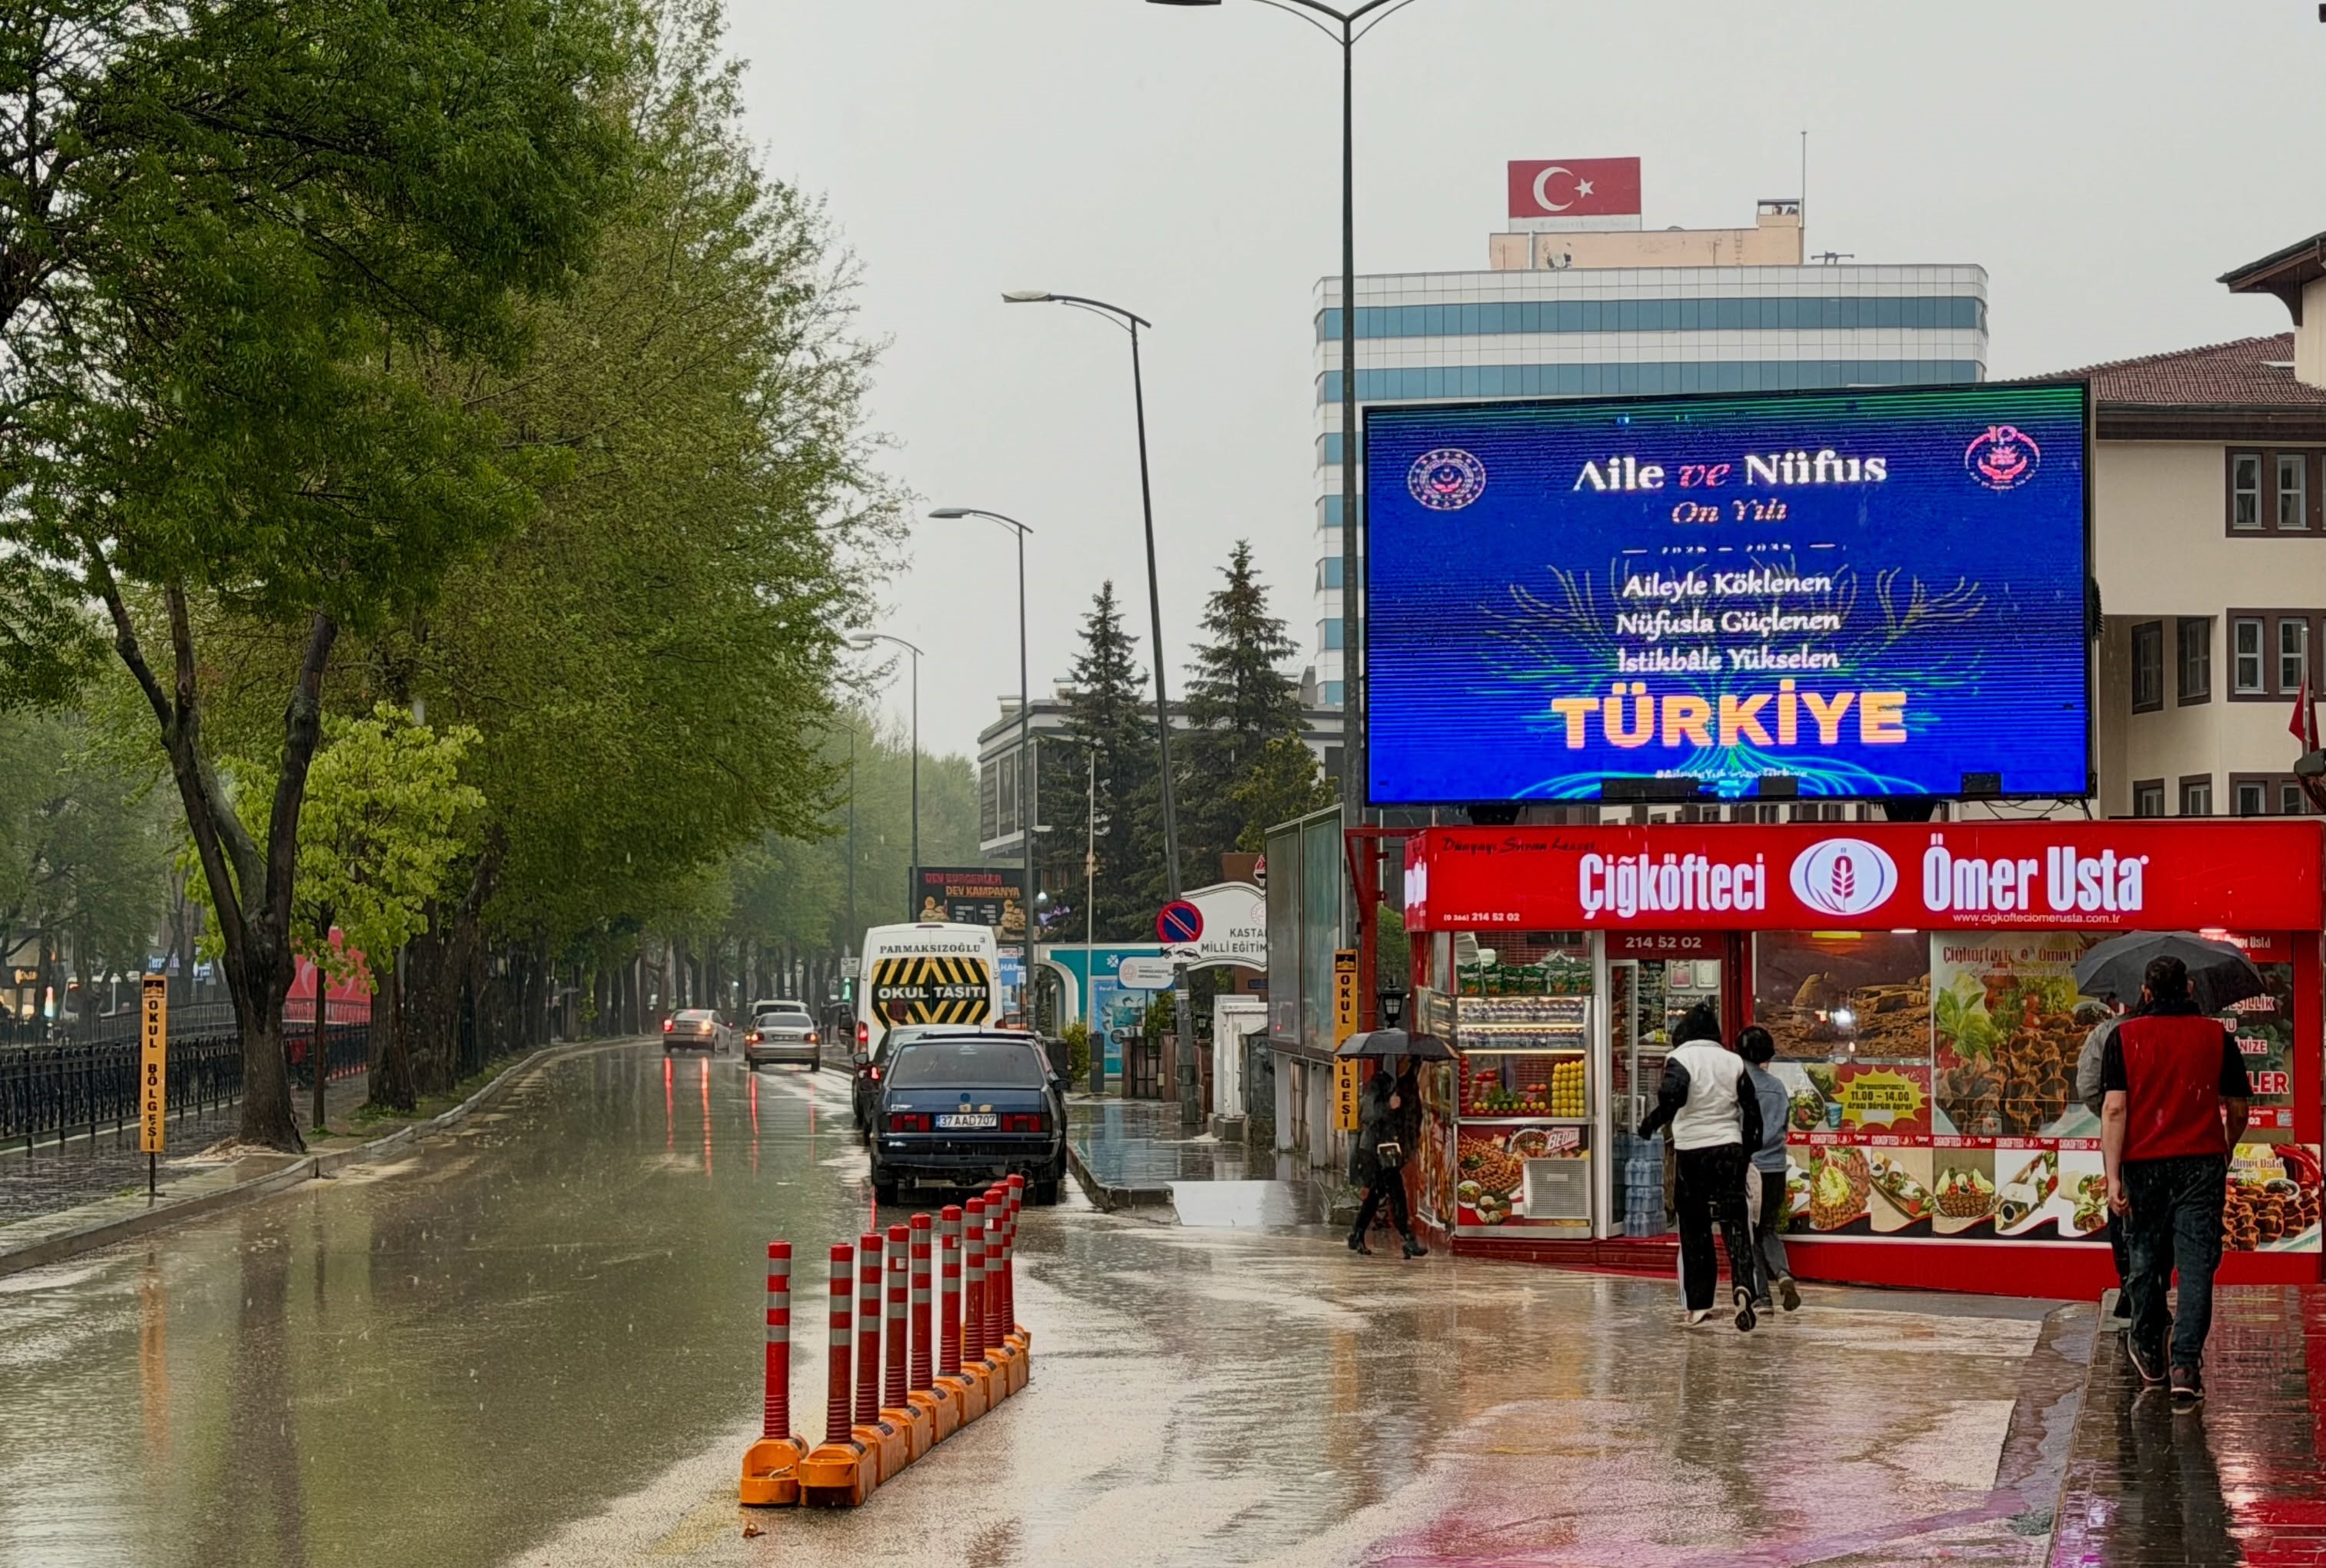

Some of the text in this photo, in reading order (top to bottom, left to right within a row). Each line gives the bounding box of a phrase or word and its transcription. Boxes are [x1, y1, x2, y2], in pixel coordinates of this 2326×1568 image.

[1573, 450, 1887, 491] Aile ve Nüfus
[1671, 498, 1788, 524] On Yılı
[1622, 571, 1832, 603] Aileyle Köklenen
[1617, 607, 1841, 641] Nüfusla Güçlenen
[1618, 644, 1839, 672] İstikbâle Yükselen
[1551, 679, 1907, 749] TÜRKİYE
[925, 873, 944, 884] DEV
[1923, 833, 2146, 911] Ömer Usta
[946, 886, 1020, 898] DEV KAMPANYA
[1579, 853, 1765, 920] Çiğköfteci
[1471, 913, 1490, 921] 214
[1492, 913, 1504, 921] 52
[1507, 913, 1520, 921] 02
[1953, 912, 2121, 924] www.cigkofteciomerusta.com.tr
[880, 942, 981, 954] PARMAKSIZOĞLU
[1201, 940, 1229, 953] MİLLİ
[1625, 935, 1701, 948] 214 52 02
[878, 987, 929, 999] OKUL
[1341, 975, 1351, 1024] OKUL
[148, 1000, 158, 1048] OKUL
[147, 1064, 158, 1149] BÖLGESİ
[1851, 1091, 1873, 1100] 11.00
[1884, 1091, 1909, 1101] 14.00
[941, 1115, 996, 1125] 37 AAD 707
